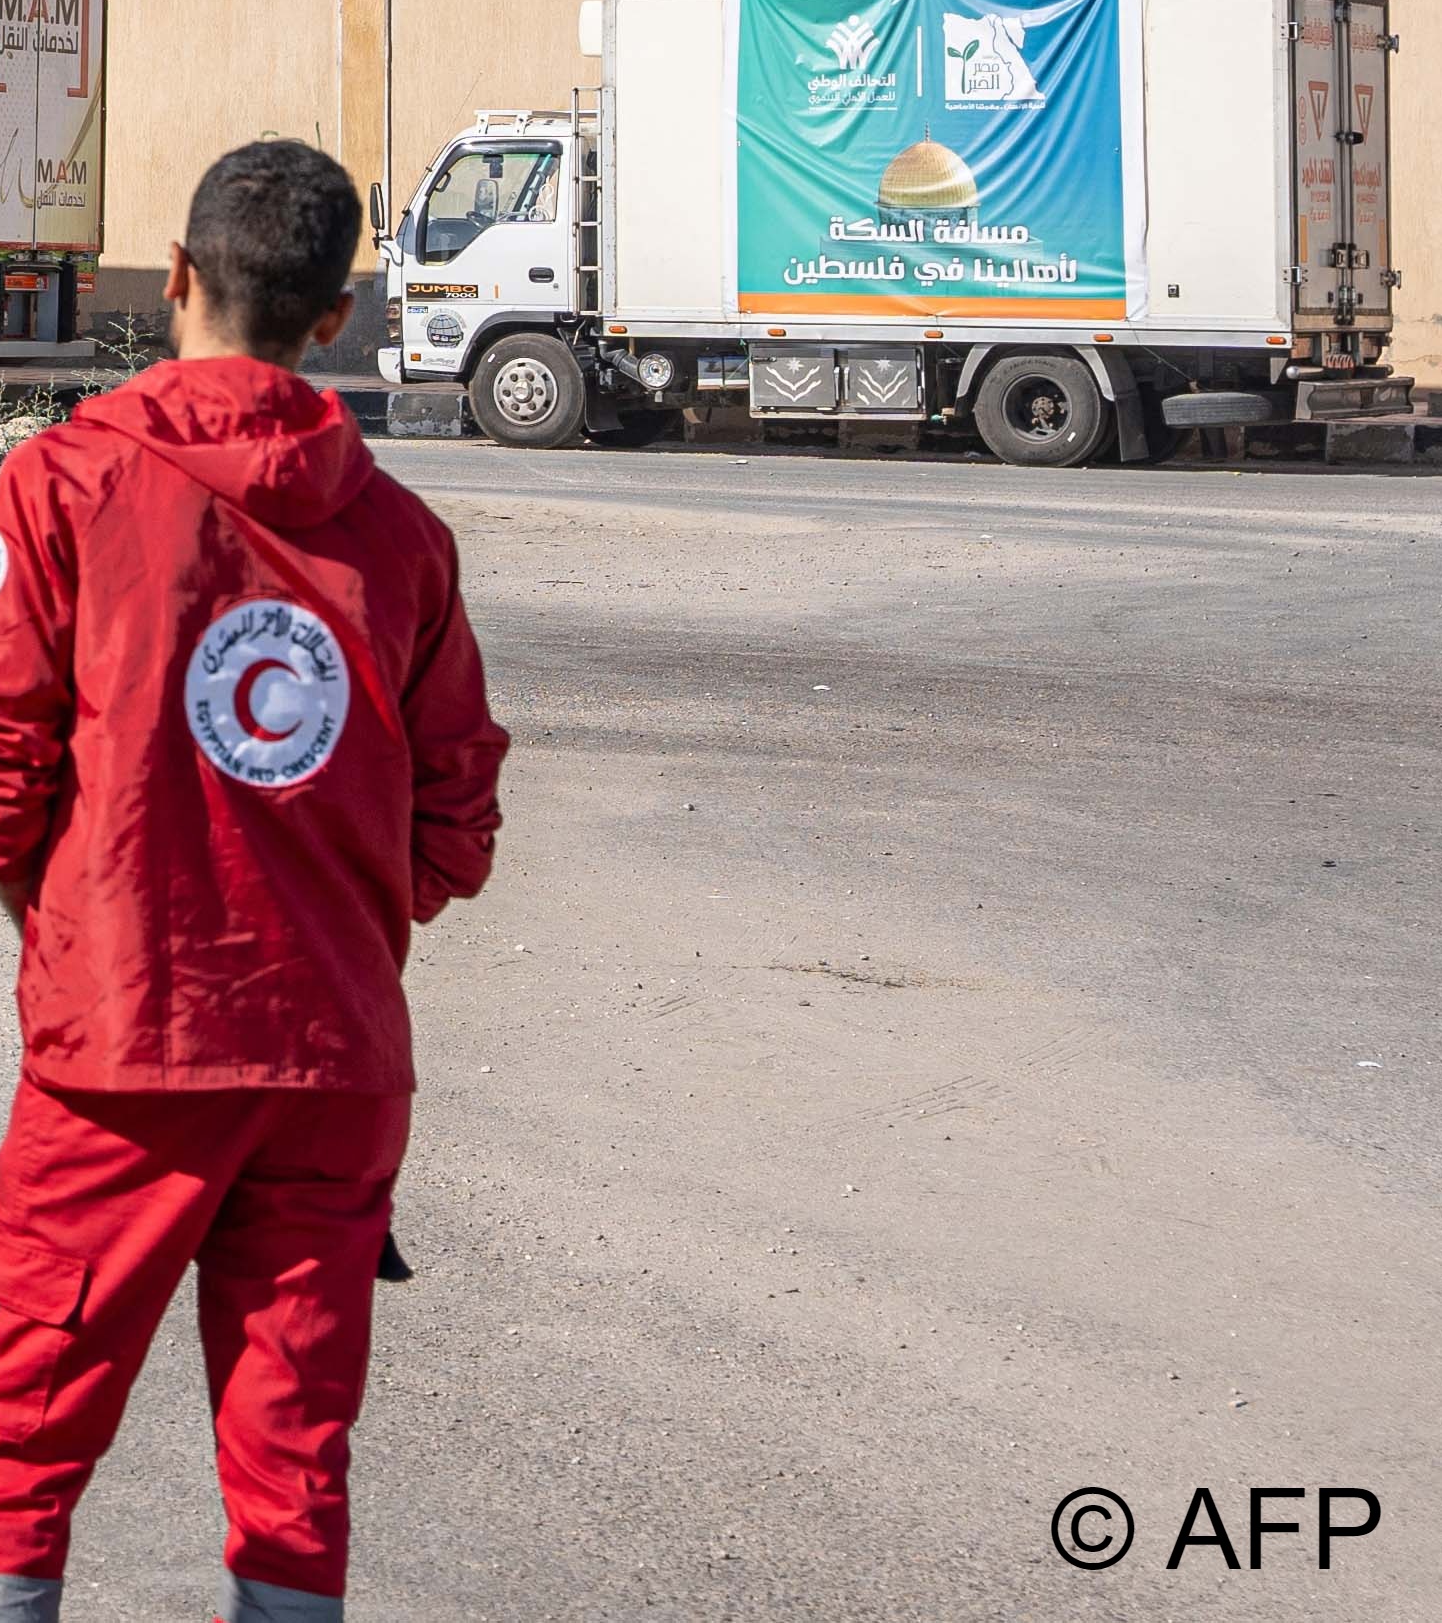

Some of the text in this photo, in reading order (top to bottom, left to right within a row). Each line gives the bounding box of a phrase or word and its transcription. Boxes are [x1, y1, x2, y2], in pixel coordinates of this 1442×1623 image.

[32, 28, 79, 55] لخدمات
[38, 159, 87, 184] M.A.M
[829, 216, 1029, 244] مسافة السكة
[783, 253, 1078, 288] لأهالينا في فلسطين
[408, 284, 477, 293] JUMBO
[196, 699, 336, 783] EGYPTIAN RED CRESCENT
